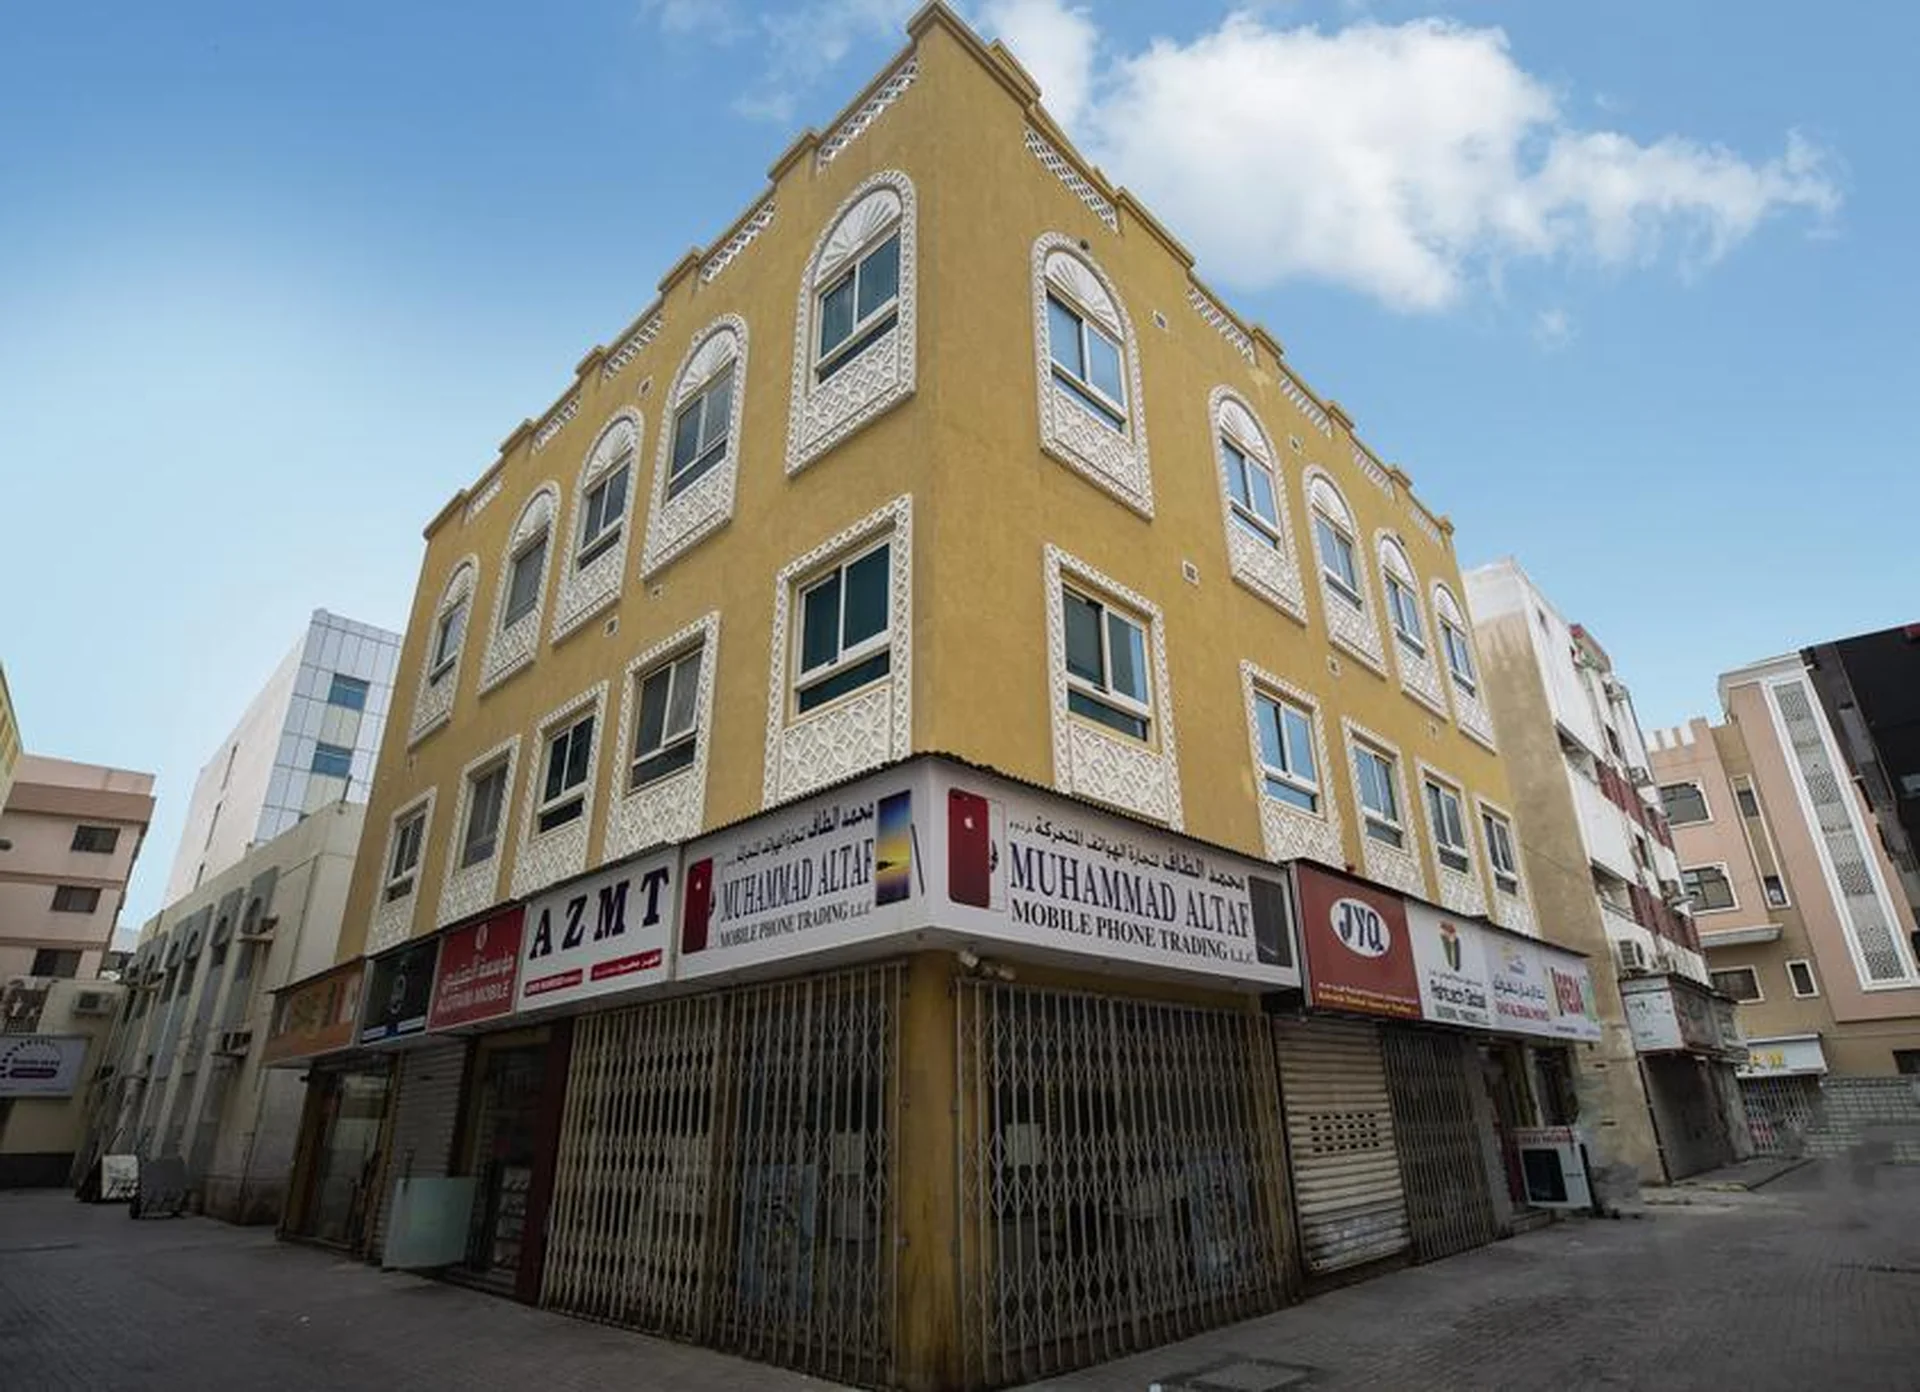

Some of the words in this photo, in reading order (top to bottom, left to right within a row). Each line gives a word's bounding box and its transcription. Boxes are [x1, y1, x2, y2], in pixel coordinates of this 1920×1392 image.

[720, 858, 813, 923] MUHAMMAD
[817, 837, 875, 897] ALTAF
[1009, 842, 1177, 922] MUHAMMAD
[1186, 888, 1249, 938] ALTAF
[719, 923, 758, 948] MOBILE
[759, 914, 796, 940] PHONE
[797, 900, 849, 931] TRADING
[1011, 897, 1093, 936] MOBILE
[1096, 915, 1157, 948] PHONE
[1158, 928, 1228, 960] TRADING
[1338, 901, 1385, 952] JYQ
